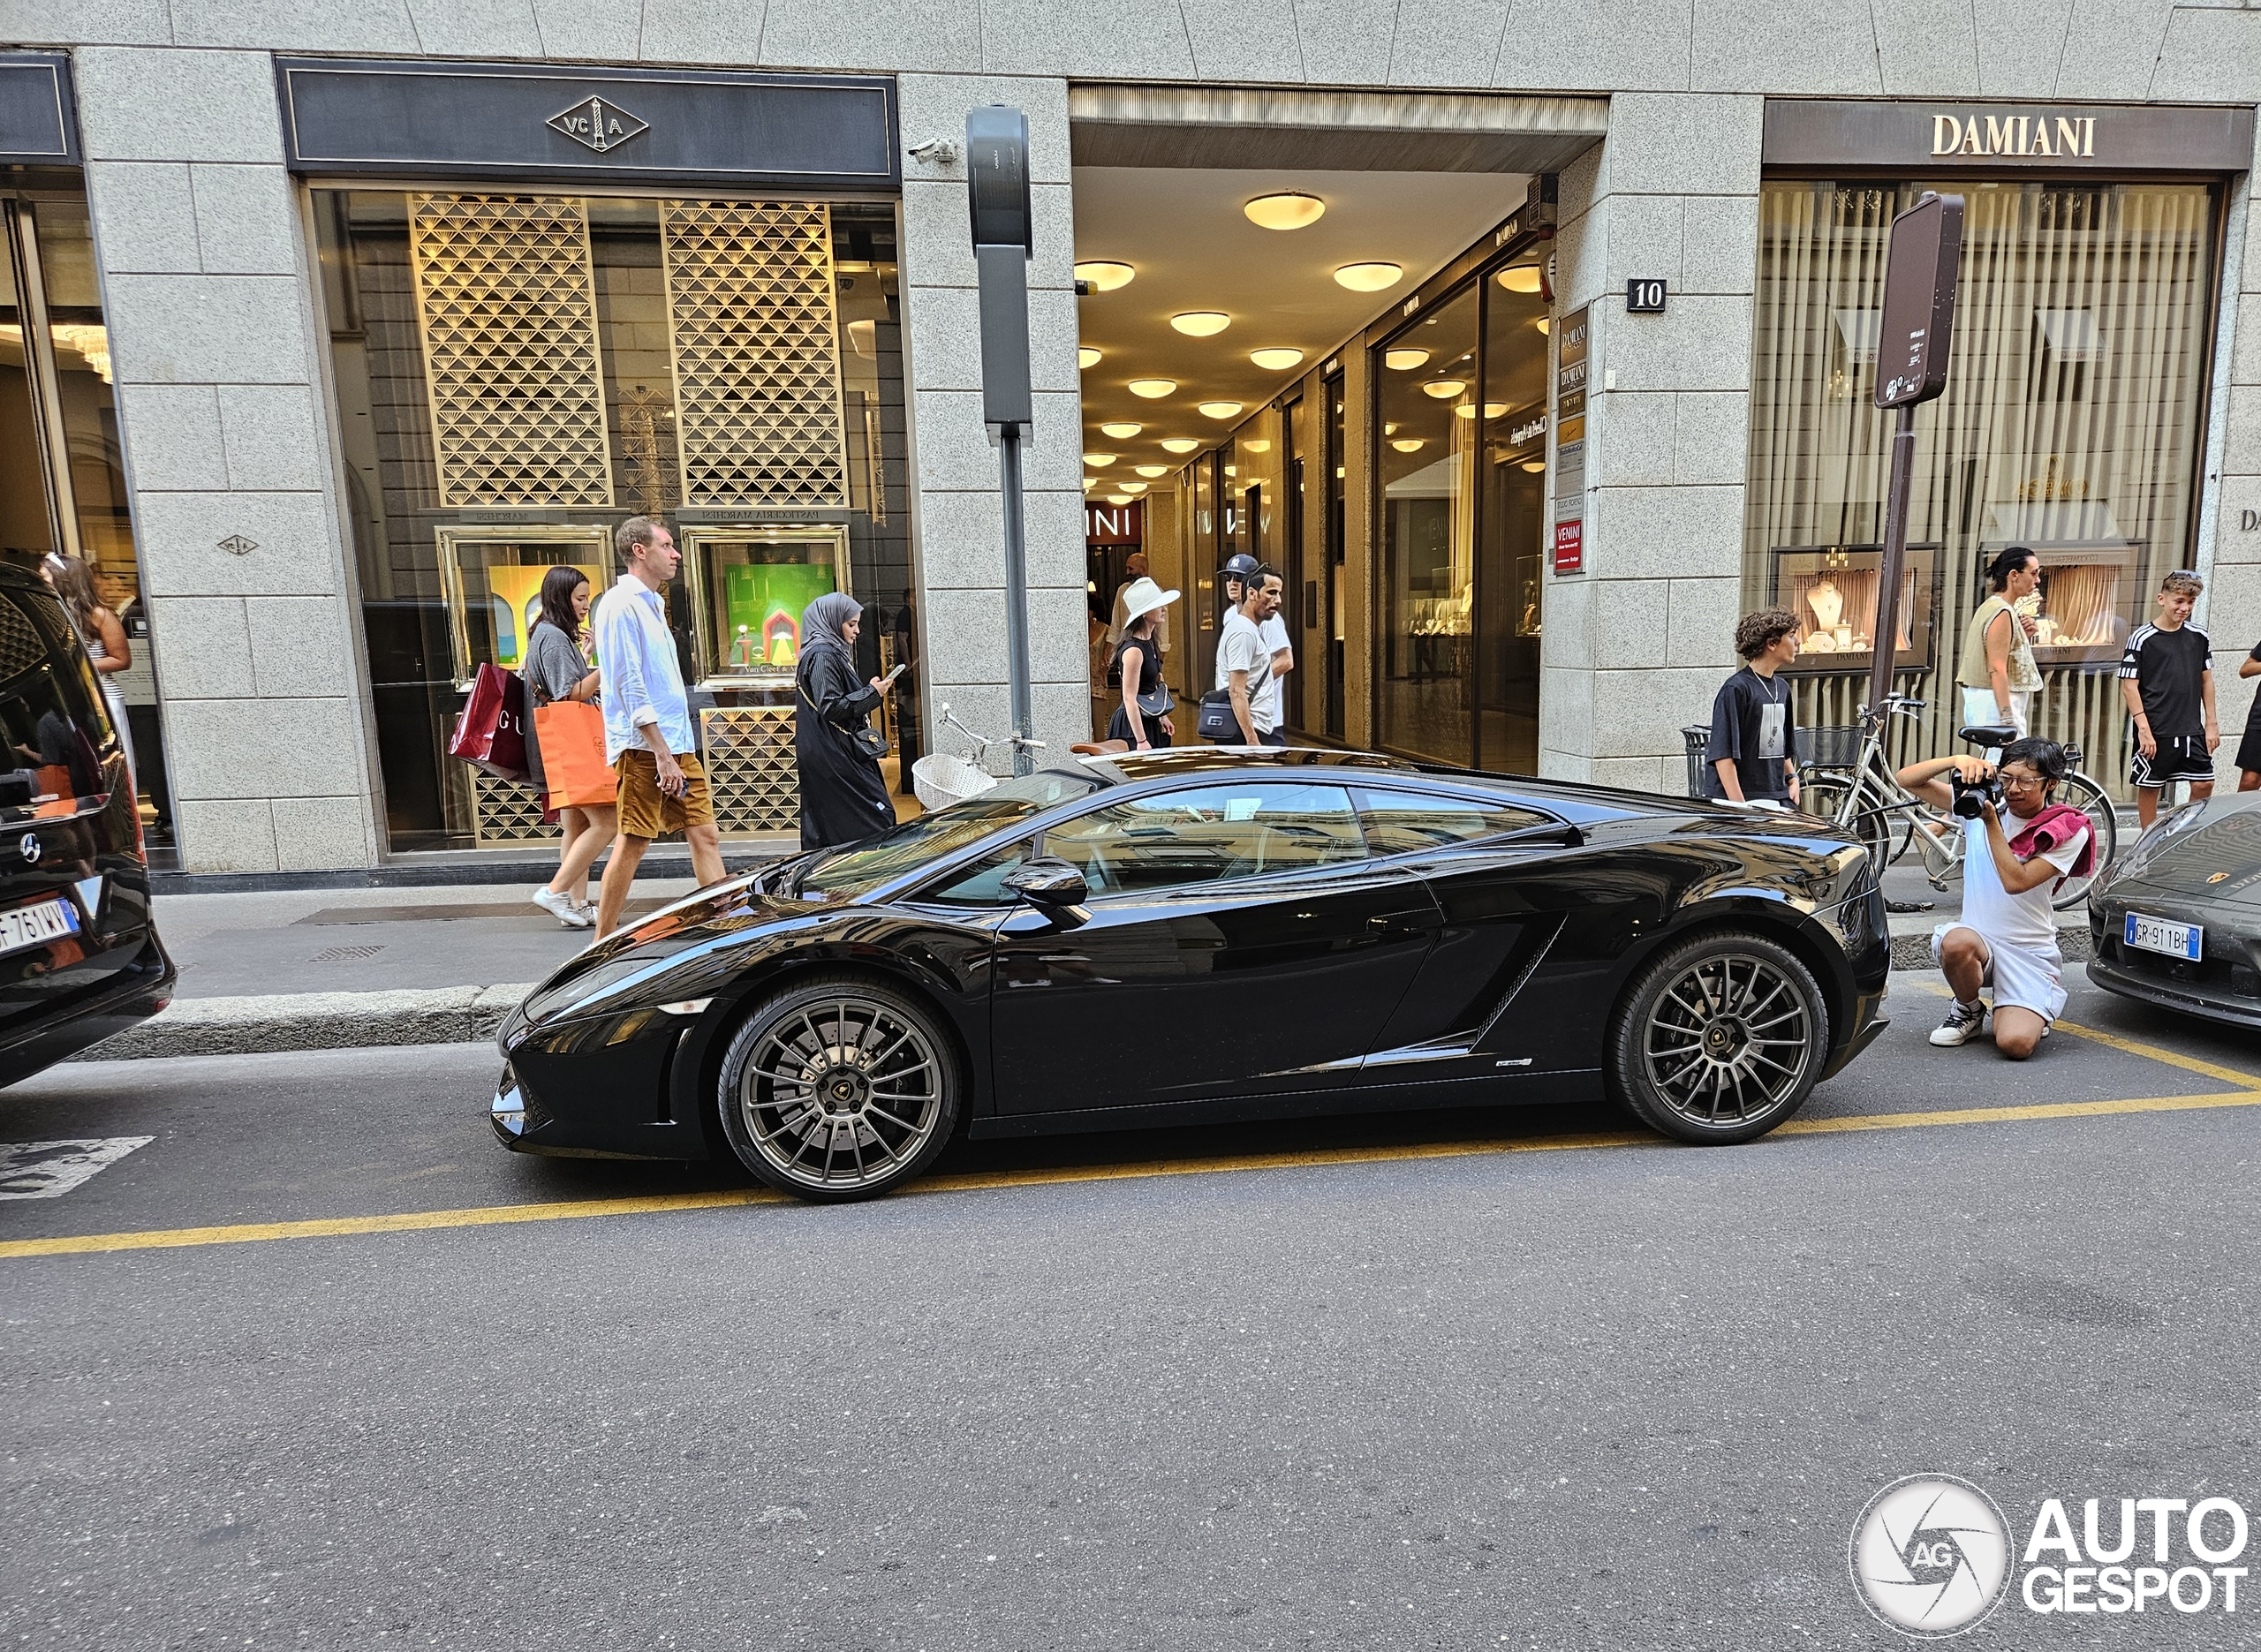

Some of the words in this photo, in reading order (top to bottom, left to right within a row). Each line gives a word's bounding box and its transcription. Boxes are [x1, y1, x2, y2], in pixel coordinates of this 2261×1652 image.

[563, 117, 588, 133] VC
[609, 118, 624, 134] A
[1931, 114, 2097, 157] DAMIANI
[1636, 283, 1662, 307] 10
[1557, 524, 1581, 541] VENINI
[1836, 653, 1868, 661] DAMIANI
